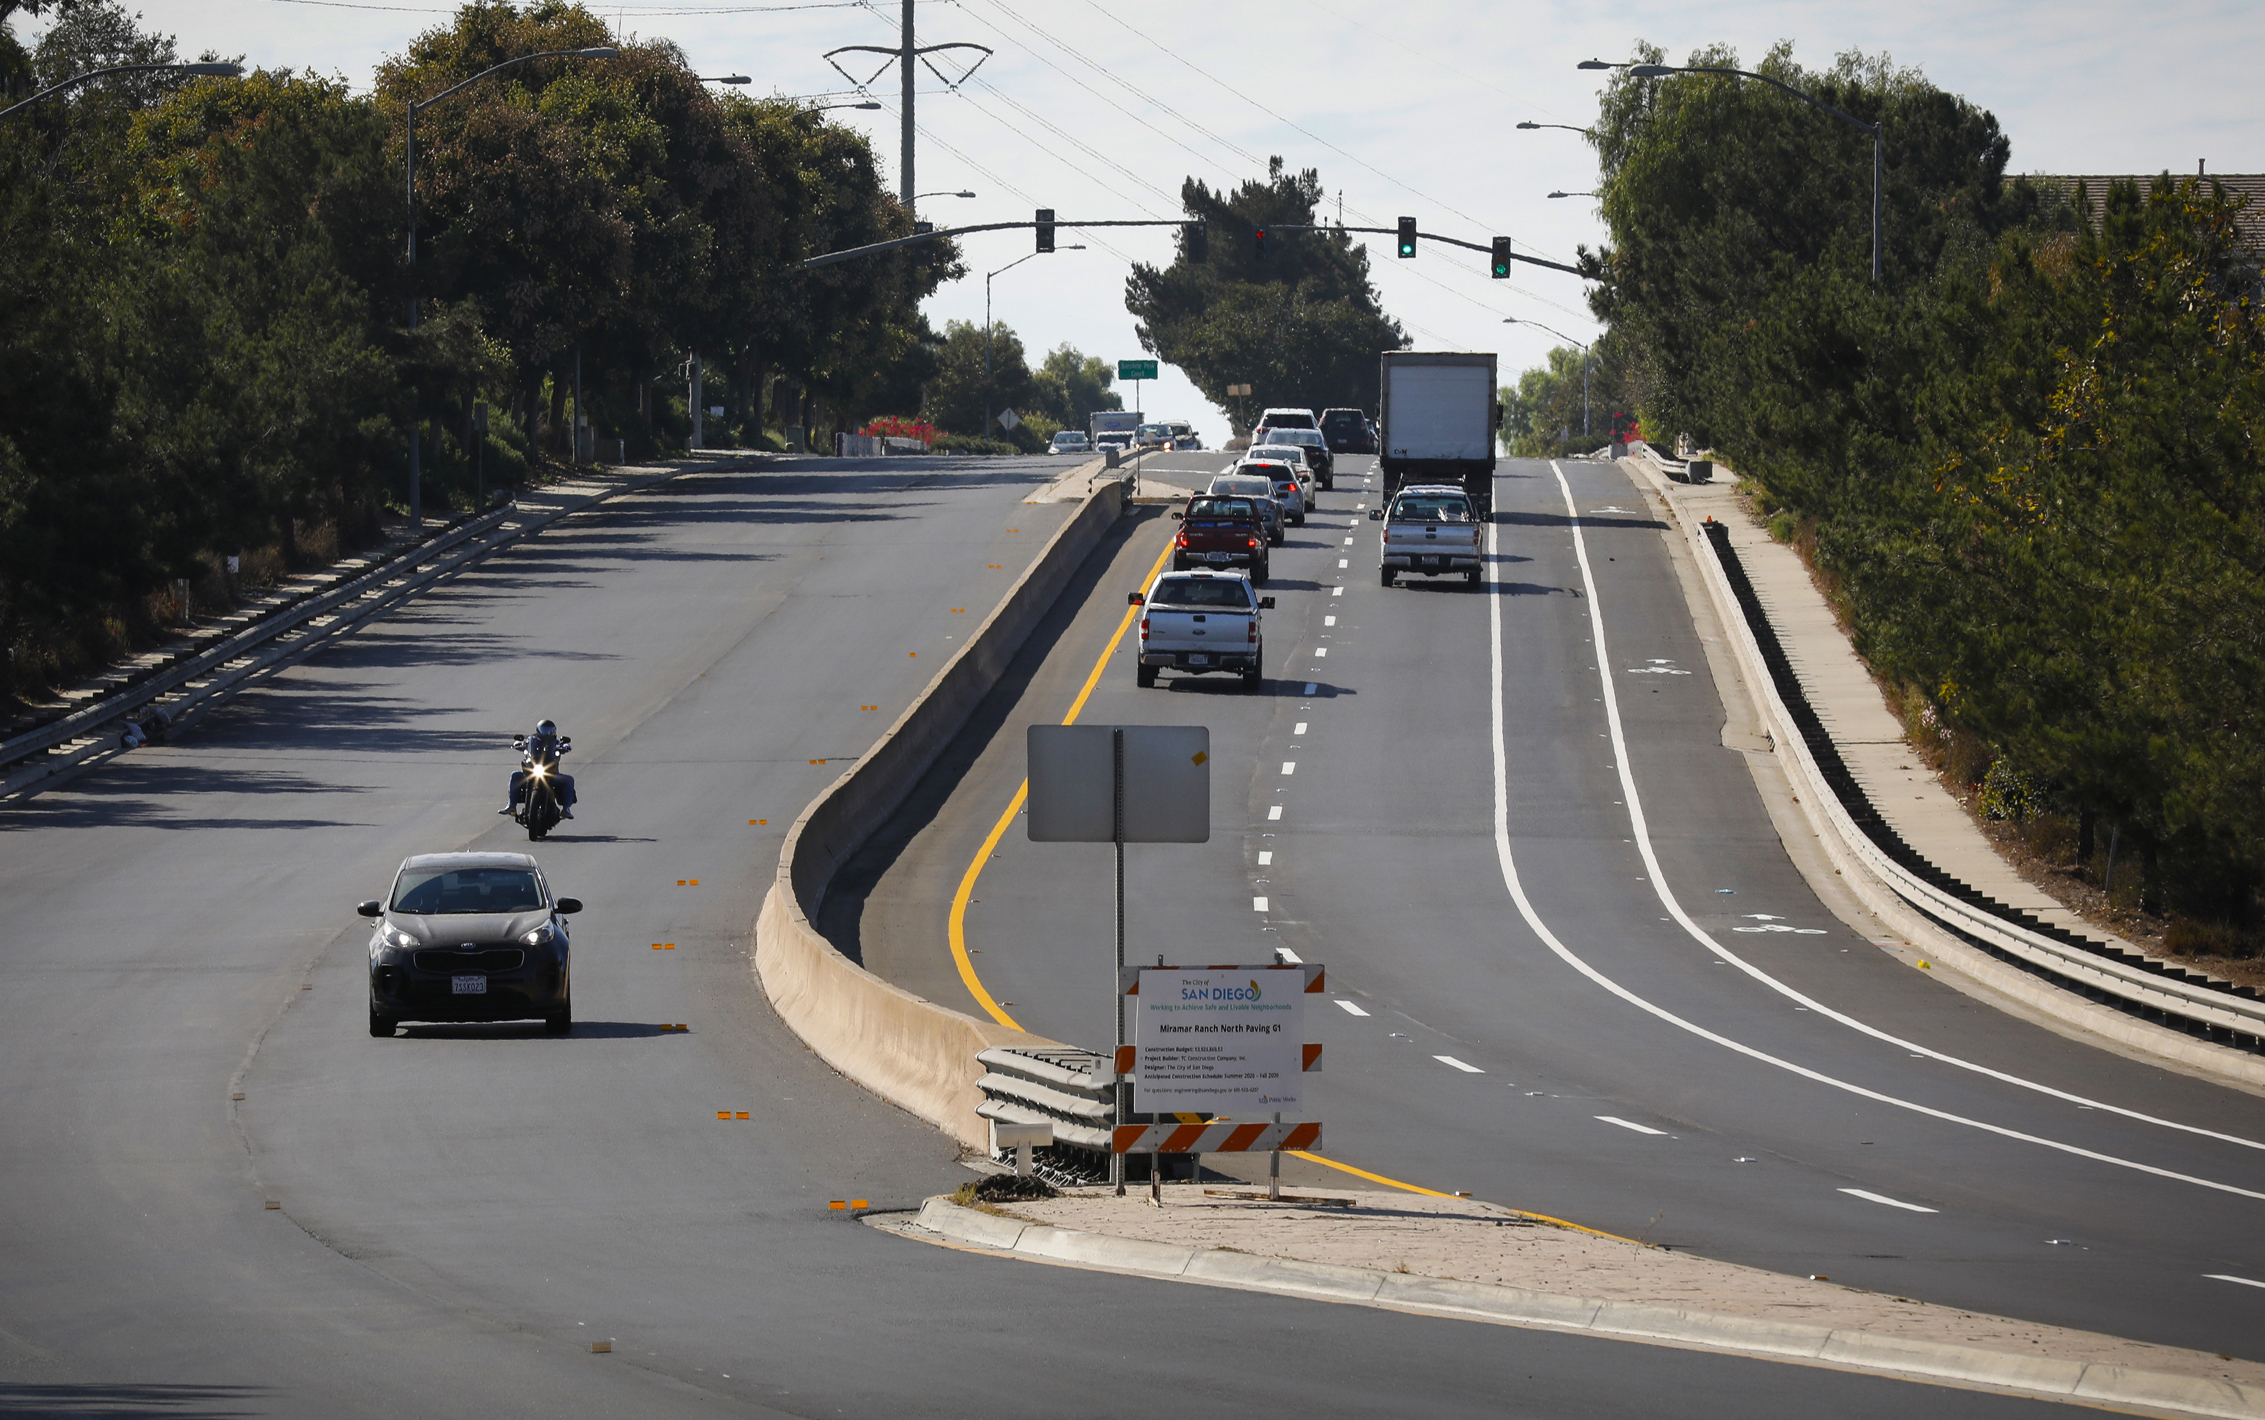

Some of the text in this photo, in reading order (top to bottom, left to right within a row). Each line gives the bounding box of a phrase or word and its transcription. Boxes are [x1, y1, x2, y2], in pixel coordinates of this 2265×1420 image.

[1181, 987, 1255, 1001] SAN DIEGO
[1150, 1004, 1173, 1012] Working
[1181, 1003, 1204, 1011] Achieve
[1204, 1003, 1217, 1011] Safe
[1218, 1003, 1229, 1011] and
[1229, 1003, 1250, 1011] Livable
[1250, 1003, 1292, 1012] Neighborhoods
[1159, 1024, 1282, 1035] Miramar Ranch North Paving G1
